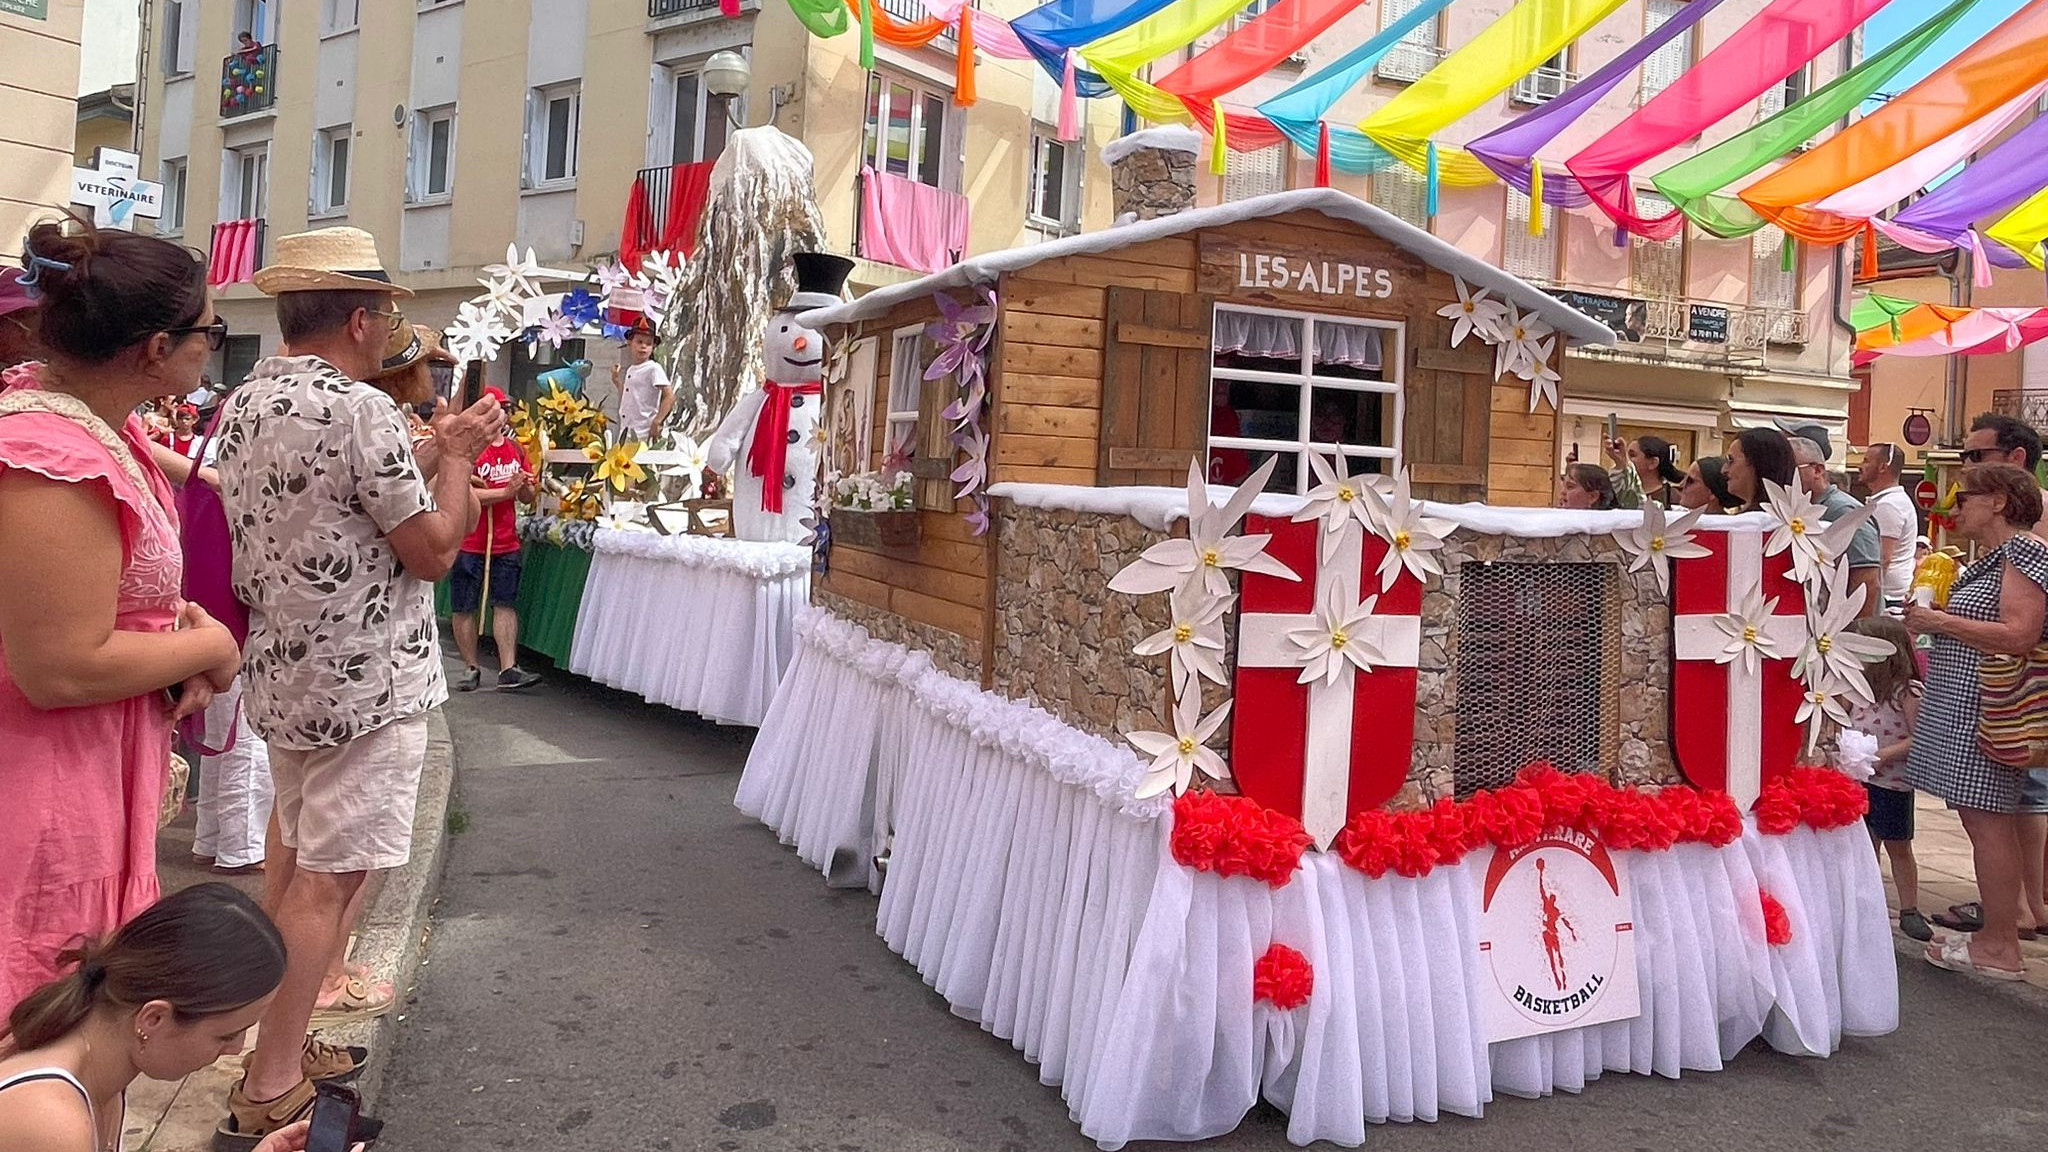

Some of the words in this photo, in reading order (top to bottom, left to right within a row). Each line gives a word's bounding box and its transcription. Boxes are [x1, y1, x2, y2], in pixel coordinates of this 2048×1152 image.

[105, 160, 133, 169] DOCTEUR
[78, 182, 154, 204] VETERINAIRE
[1239, 253, 1393, 298] LES-ALPES
[1698, 307, 1727, 318] VENDRE
[1513, 973, 1604, 1015] BASKETBALL
